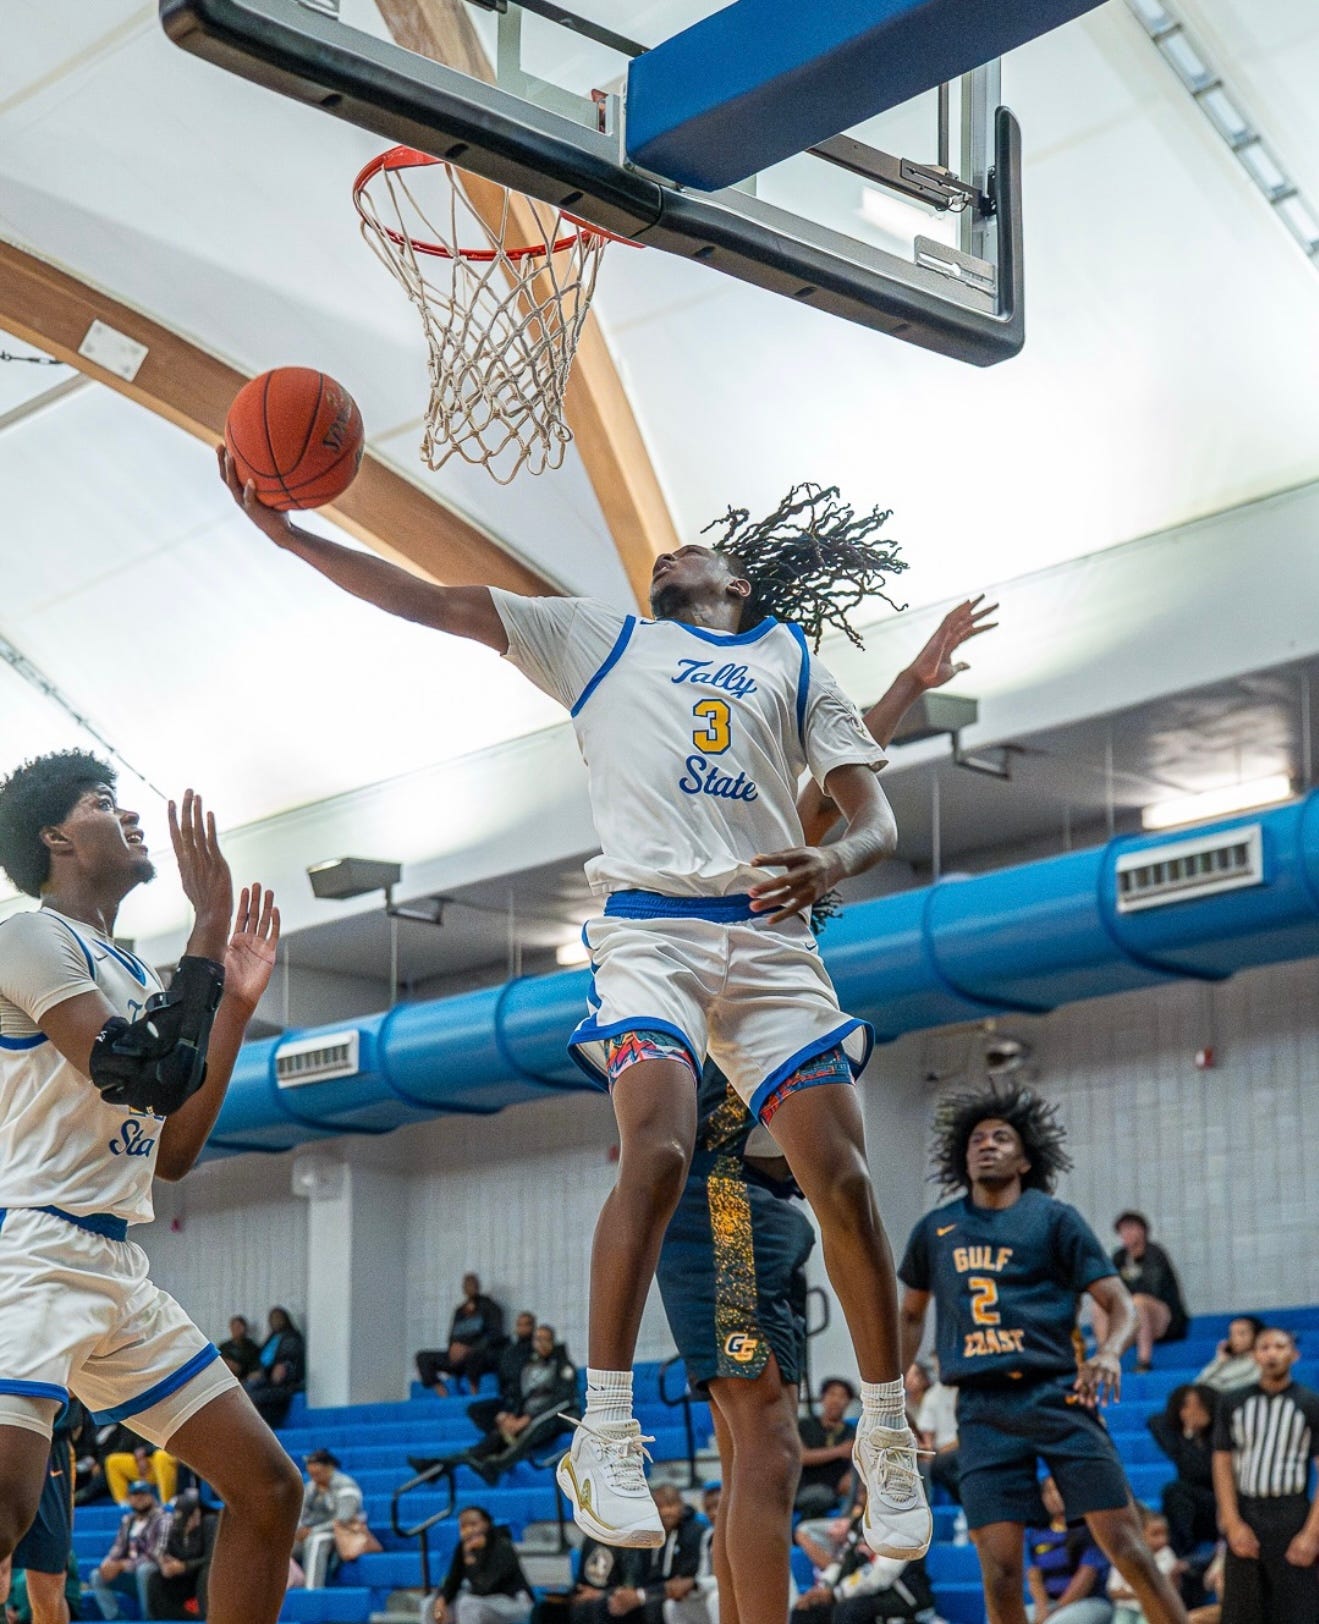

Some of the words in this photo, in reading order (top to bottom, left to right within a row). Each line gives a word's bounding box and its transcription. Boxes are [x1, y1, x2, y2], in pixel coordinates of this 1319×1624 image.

[671, 658, 758, 699] Tally
[693, 698, 732, 755] 3
[679, 754, 758, 802] State
[953, 1245, 1013, 1273] GULF
[968, 1276, 1001, 1325] 2
